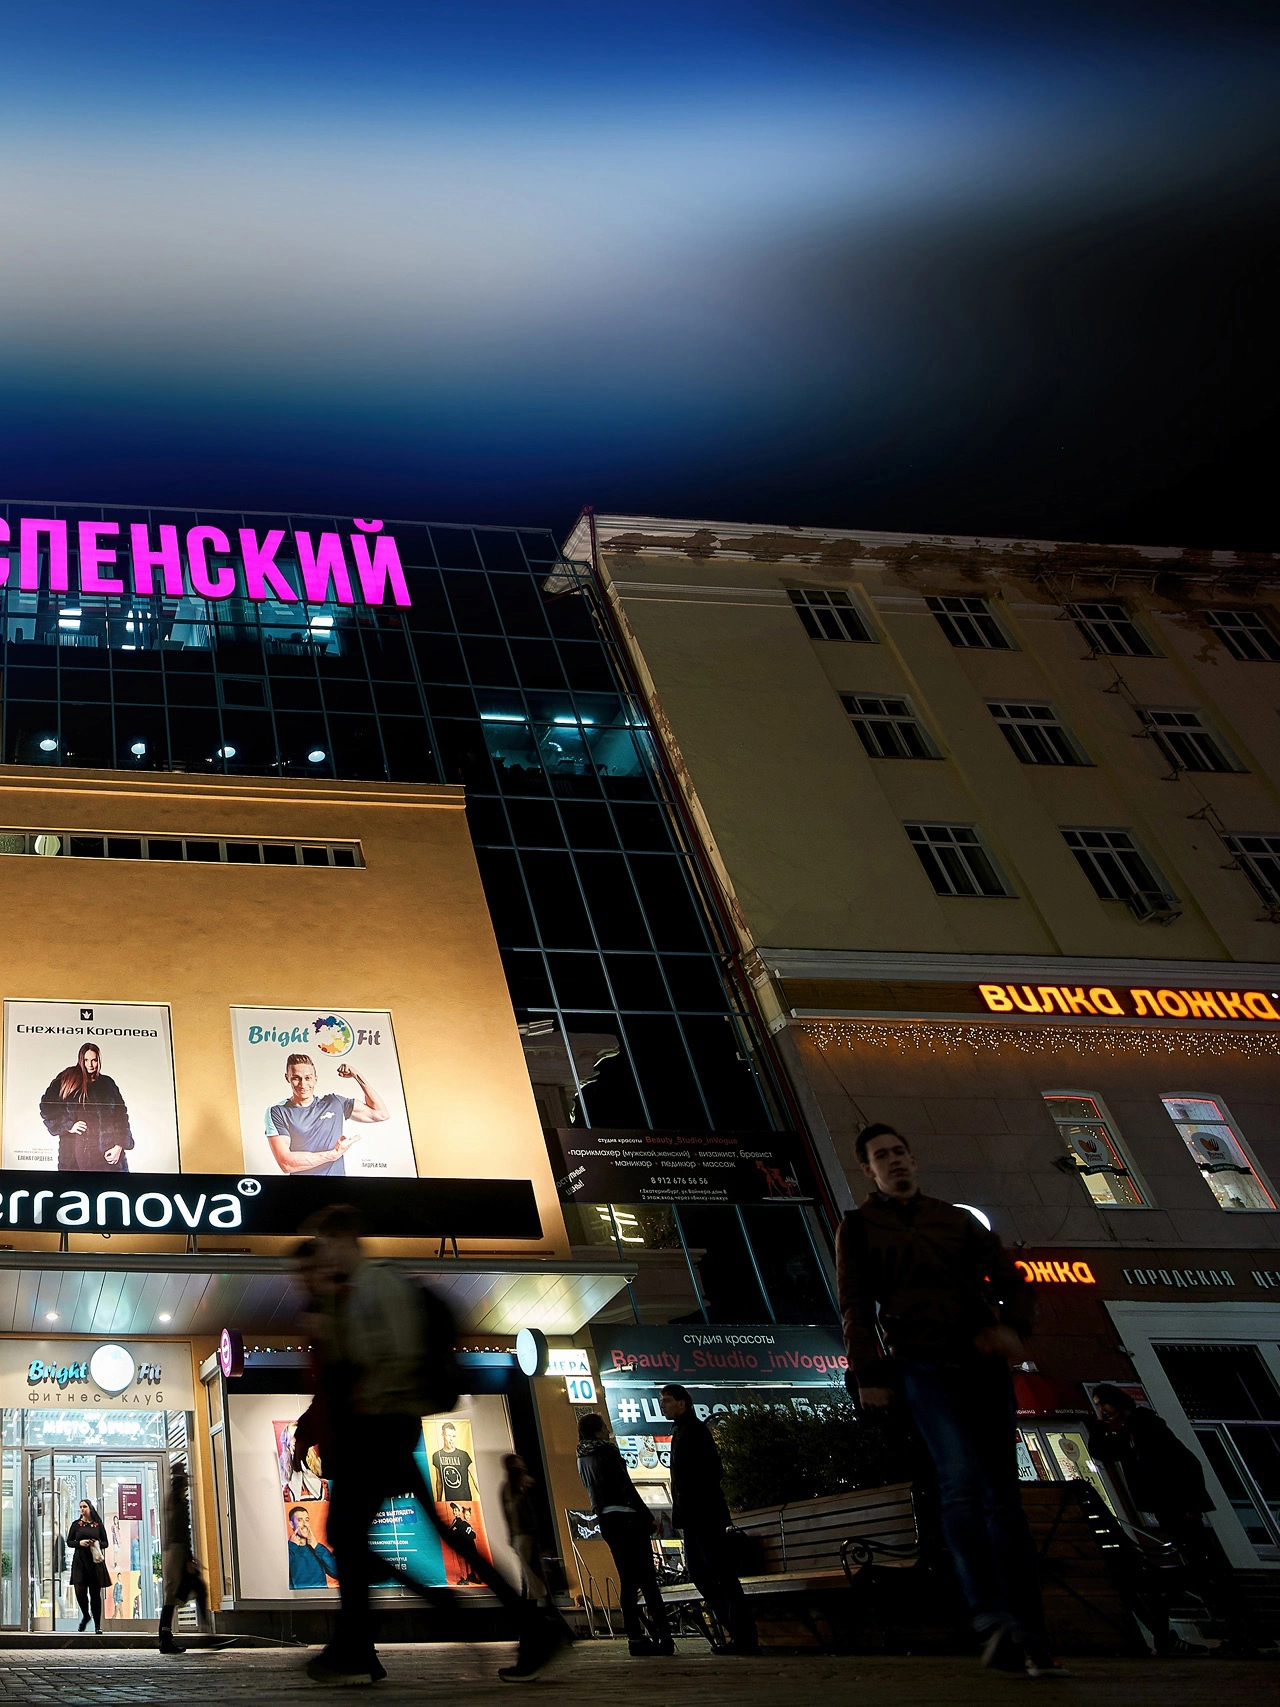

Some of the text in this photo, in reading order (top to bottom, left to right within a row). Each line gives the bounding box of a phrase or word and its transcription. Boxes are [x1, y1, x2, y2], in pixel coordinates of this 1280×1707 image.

[248, 1025, 381, 1047] Bright Fit
[570, 1148, 621, 1158] парикмахер
[614, 1160, 652, 1169] маникюр
[660, 1161, 696, 1169] педикюр
[556, 1165, 586, 1188] ОСТУПНЫЕ
[650, 1176, 709, 1185] 8 912 676 56 56
[1015, 1261, 1096, 1284] ожка
[1122, 1268, 1236, 1288] ГОРОДСКАЯ
[683, 1333, 775, 1347] студия красоты
[27, 1359, 162, 1384] Bright Fit
[570, 1380, 593, 1400] 10
[440, 1456, 461, 1466] NIRVANA
[1017, 1466, 1033, 1479] ОНТ
